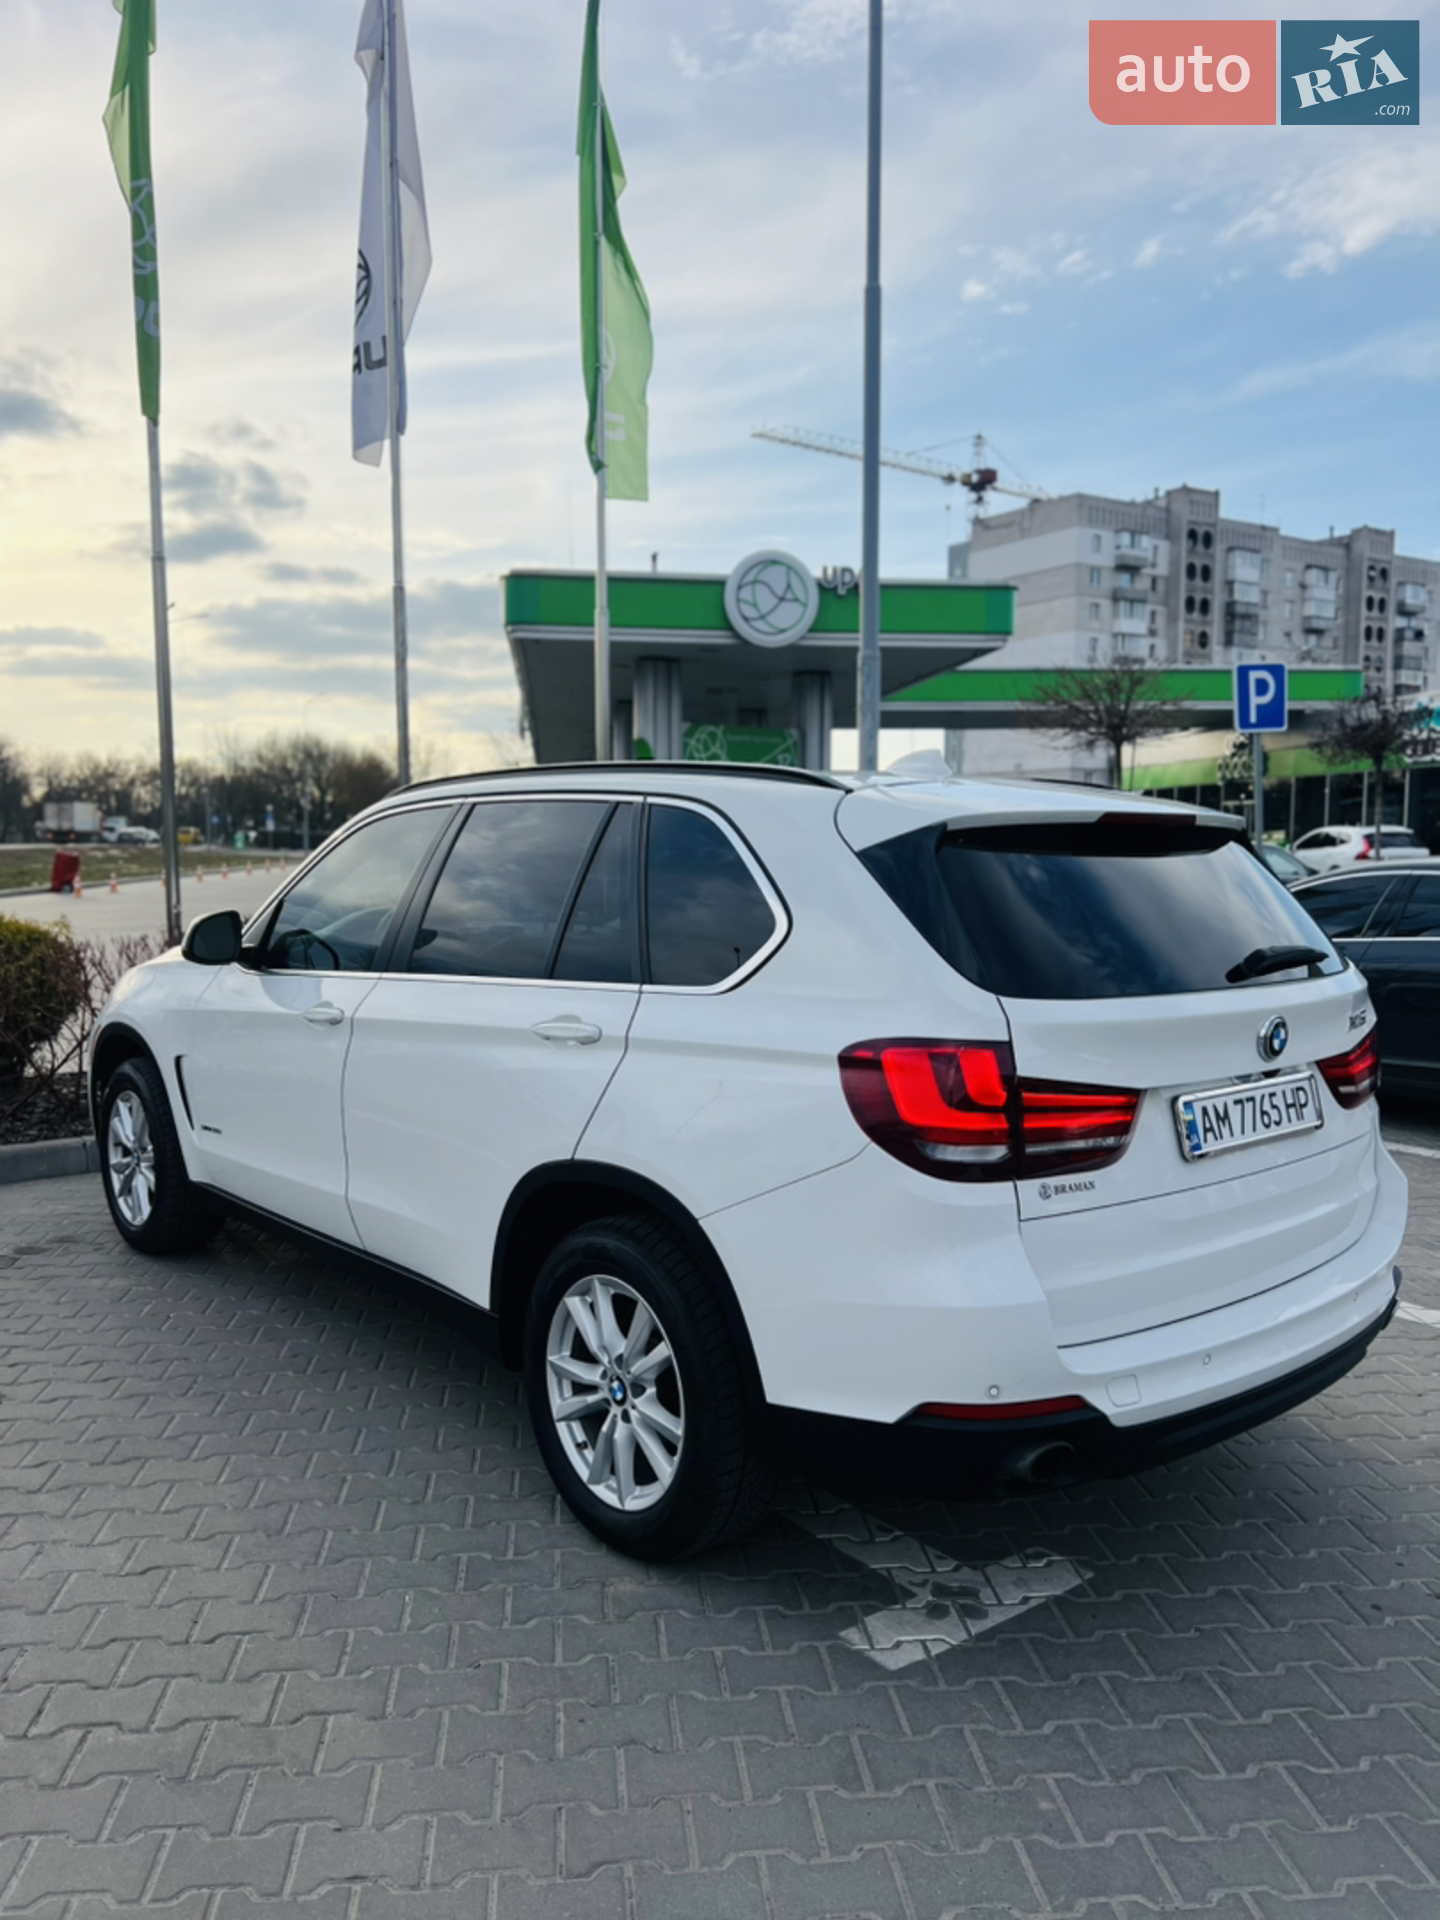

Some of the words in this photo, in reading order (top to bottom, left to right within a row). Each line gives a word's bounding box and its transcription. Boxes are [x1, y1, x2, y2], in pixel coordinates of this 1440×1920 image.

[822, 566, 863, 596] up
[1248, 669, 1276, 724] P
[1201, 1101, 1235, 1144] AM
[1233, 1092, 1283, 1136] 7765
[1281, 1085, 1309, 1124] HP
[1053, 1180, 1096, 1195] BRAMAN
